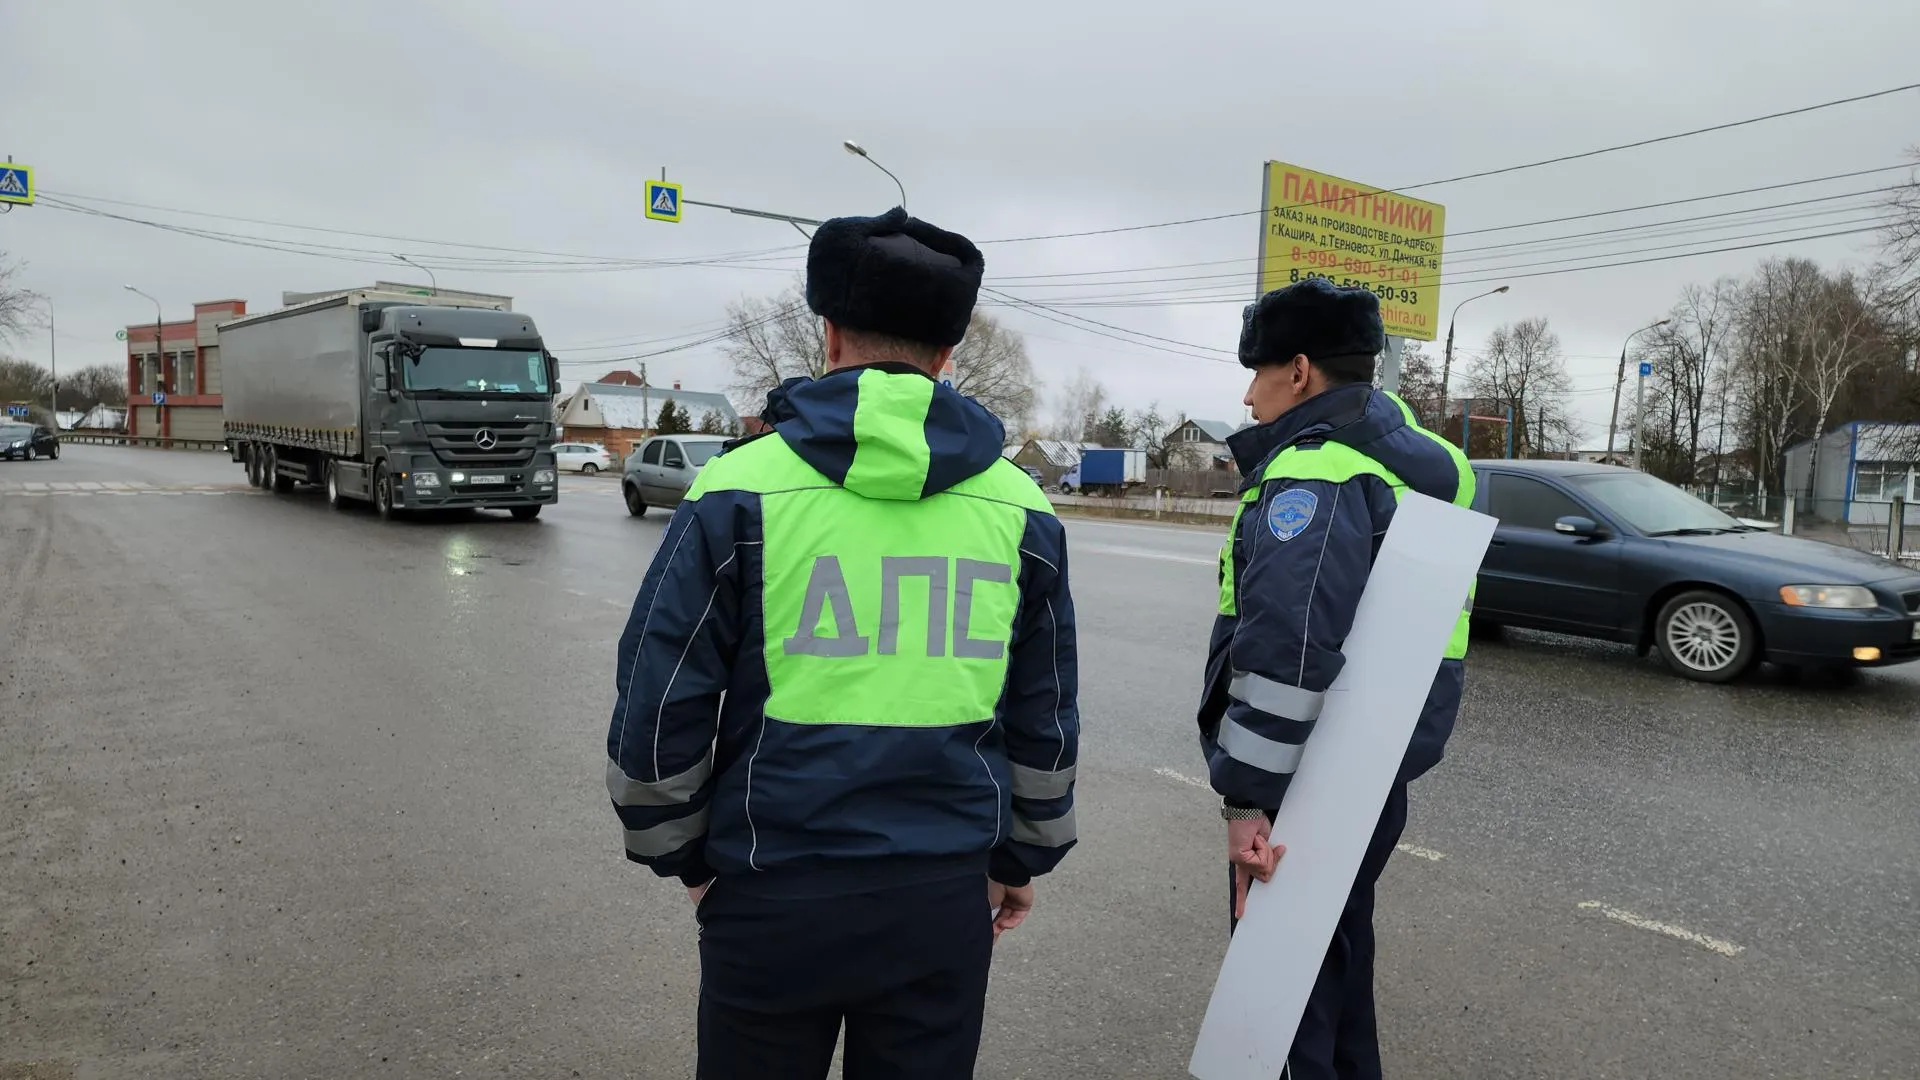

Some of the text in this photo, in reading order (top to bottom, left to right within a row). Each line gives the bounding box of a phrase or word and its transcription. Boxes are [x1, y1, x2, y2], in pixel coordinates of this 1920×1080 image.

[1283, 171, 1433, 234] ПАМЯТНИКИ
[1273, 206, 1438, 253] ЗАКАЗ НА ПРОИЗВОДСТВЕ ПО АДРЕСУ:
[1292, 246, 1418, 285] 8-999-690-51-01
[1380, 304, 1426, 326] shira.ru
[783, 555, 1012, 660] ДПС
